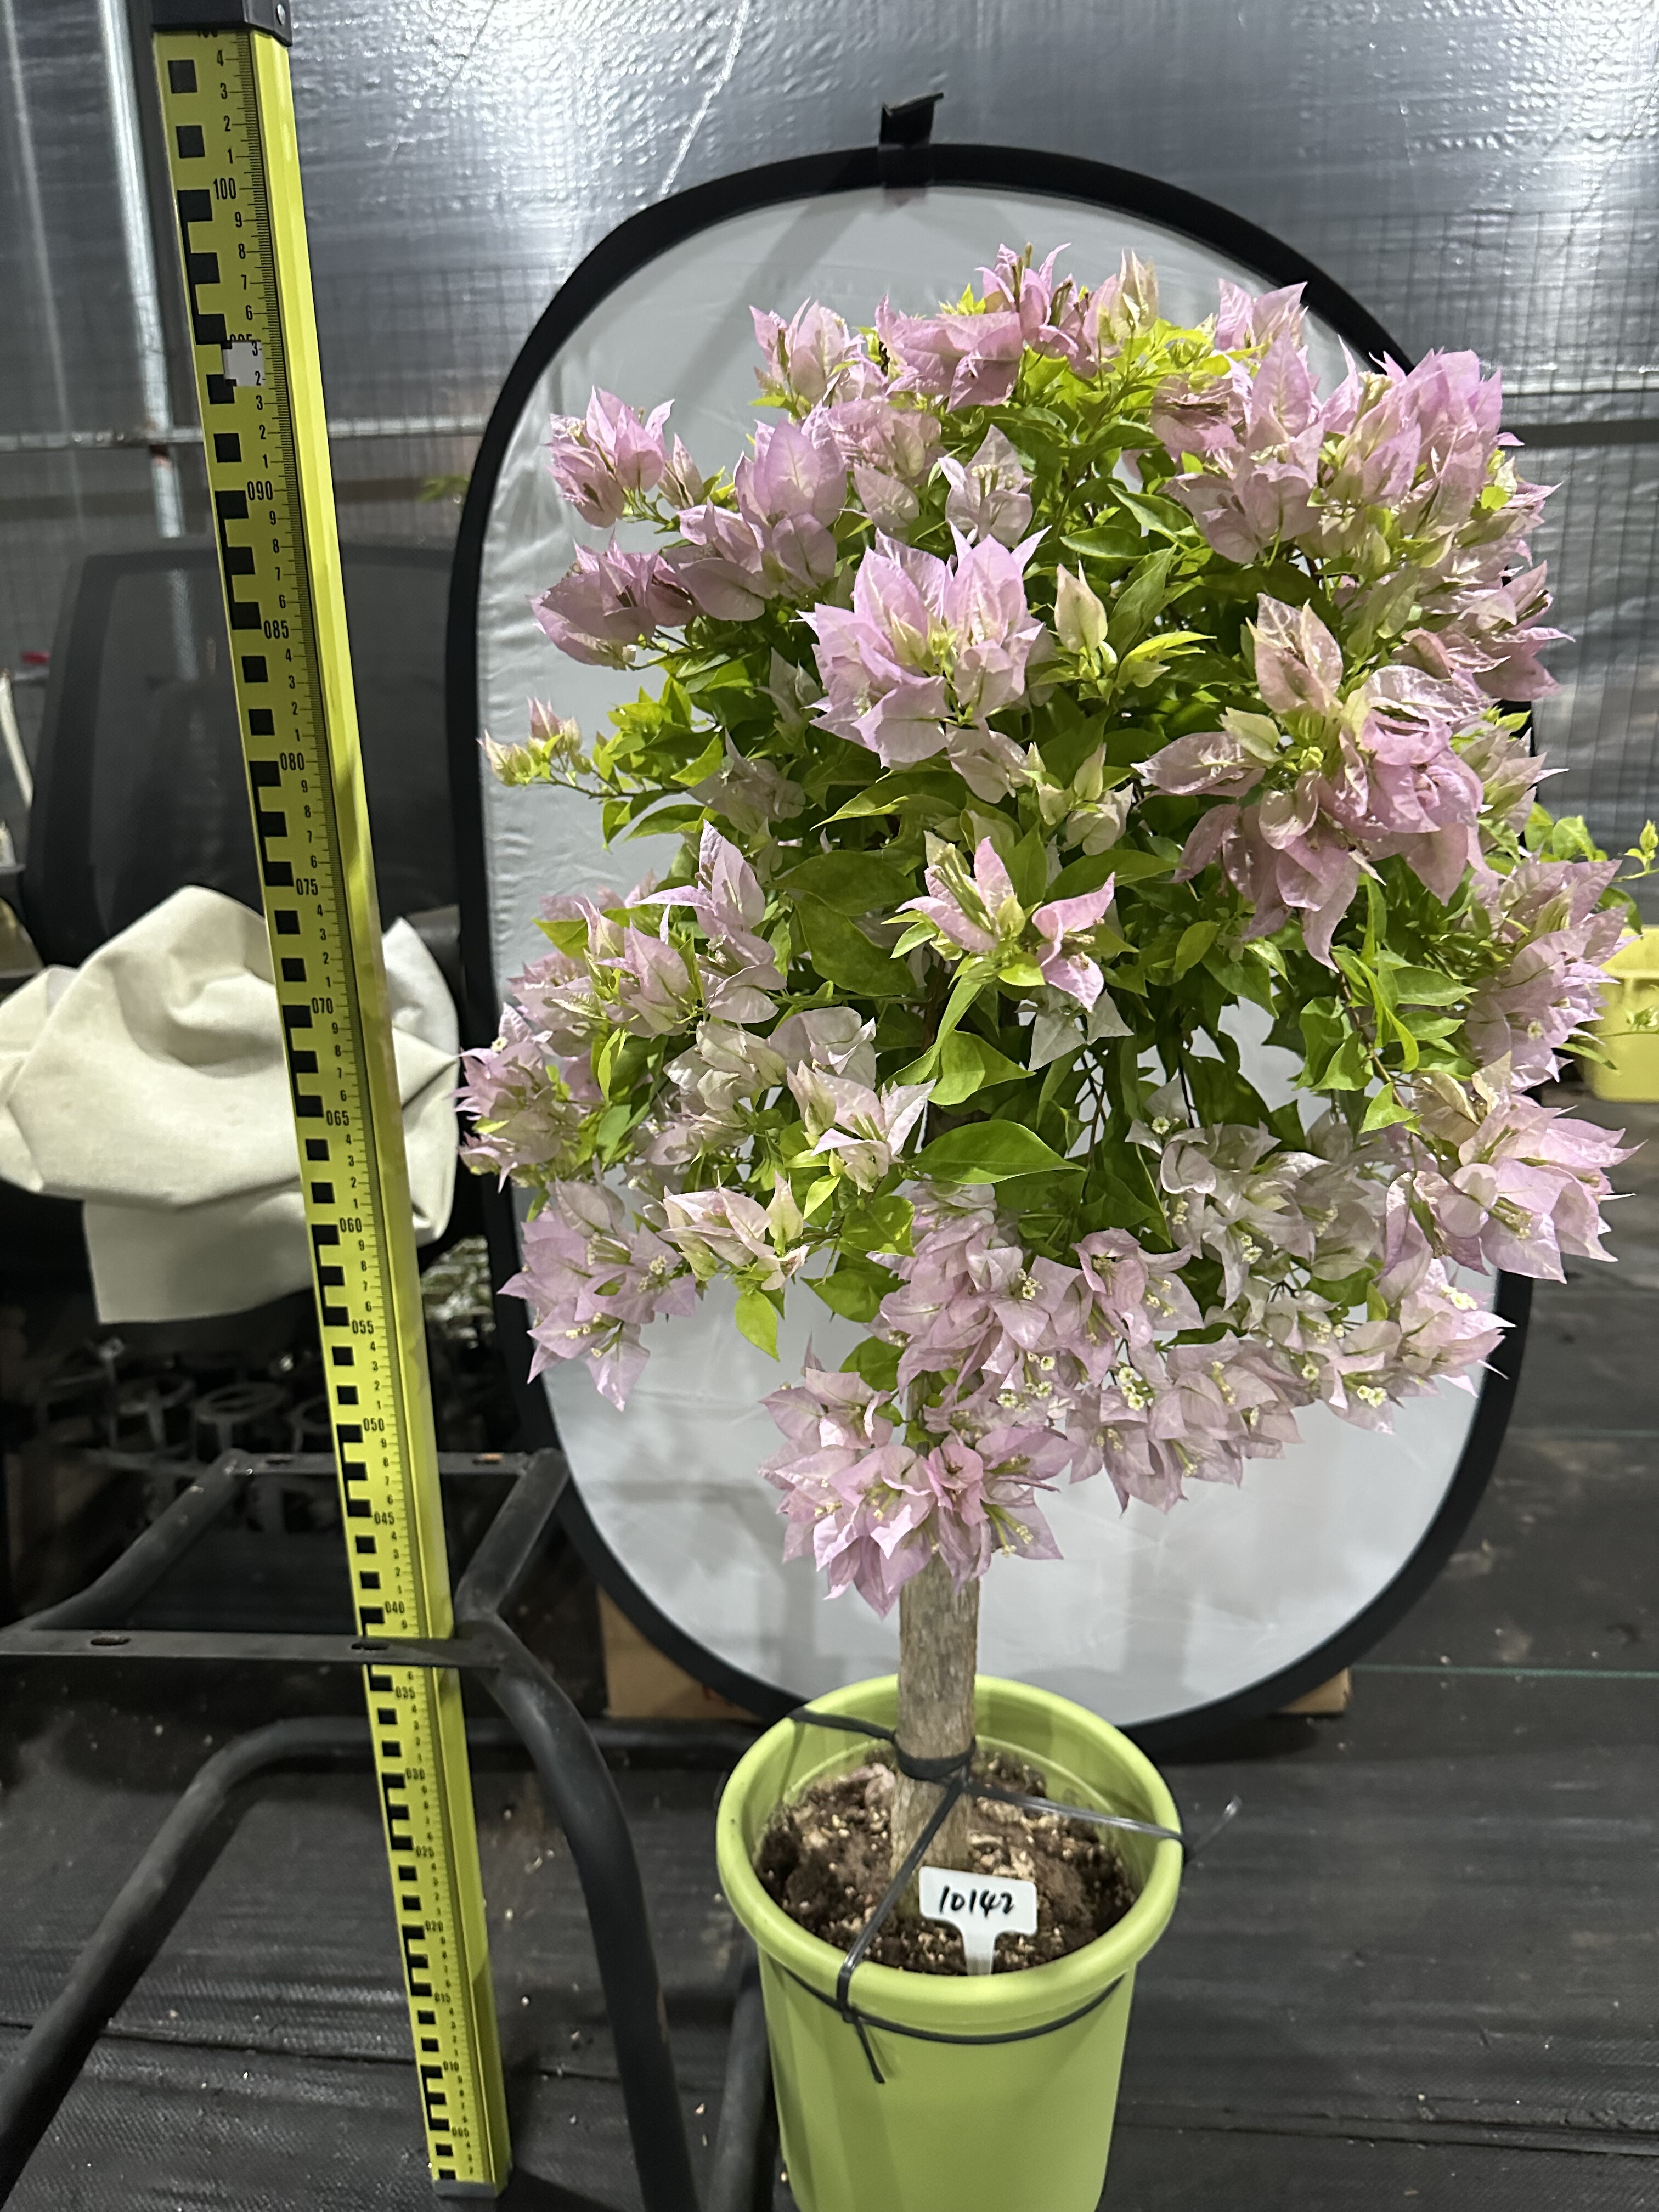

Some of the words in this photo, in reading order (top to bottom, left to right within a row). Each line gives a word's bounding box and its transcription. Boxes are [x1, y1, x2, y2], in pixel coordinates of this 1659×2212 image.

[217, 50, 224, 66] 4
[220, 83, 228, 99] 3
[224, 116, 230, 132] 2
[228, 148, 233, 164] 1
[213, 178, 236, 200] 100
[235, 212, 242, 228] 9
[238, 244, 246, 259] 8
[241, 274, 246, 290] 7
[246, 305, 252, 320] 6
[252, 341, 258, 356] 3
[255, 371, 261, 386] 2
[256, 395, 263, 410] 3
[259, 425, 266, 439] 2
[263, 454, 268, 468] 1
[247, 481, 273, 501] 090
[269, 511, 276, 525] 9
[273, 539, 279, 553] 8
[275, 567, 280, 581] 7
[279, 595, 286, 608] 6
[264, 620, 289, 639] 085
[286, 648, 292, 662] 4
[289, 675, 295, 689] 3
[291, 702, 298, 715] 2
[295, 729, 300, 742] 1
[280, 752, 304, 770] 080
[301, 780, 308, 793] 9
[304, 805, 311, 818] 8
[307, 830, 312, 843] 7
[311, 855, 317, 868] 6
[296, 878, 318, 895] 075
[317, 904, 323, 916] 4
[320, 928, 326, 940] 3
[323, 952, 329, 964] 2
[326, 976, 331, 988] 1
[312, 997, 333, 1014] 070
[332, 1022, 338, 1034] 9
[335, 1045, 341, 1057] 8
[337, 1068, 342, 1079] 7
[340, 1090, 347, 1101] 6
[326, 1110, 349, 1126] 065
[346, 1133, 351, 1145] 4
[348, 1155, 354, 1167] 3
[351, 1177, 356, 1188] 2
[353, 1199, 358, 1209] 1
[339, 1217, 361, 1233] 060
[358, 1240, 364, 1251] 9
[361, 1260, 367, 1272] 8
[363, 1280, 368, 1291] 7
[365, 1301, 372, 1312] 6
[352, 1320, 374, 1334] 055
[370, 1341, 376, 1351] 4
[372, 1361, 378, 1371] 3
[374, 1380, 380, 1391] 2
[377, 1401, 381, 1410] 1
[363, 1418, 385, 1431] 050
[374, 1511, 394, 1525] 045
[385, 1601, 405, 1614] 040
[939, 1885, 1014, 1918] 10142
